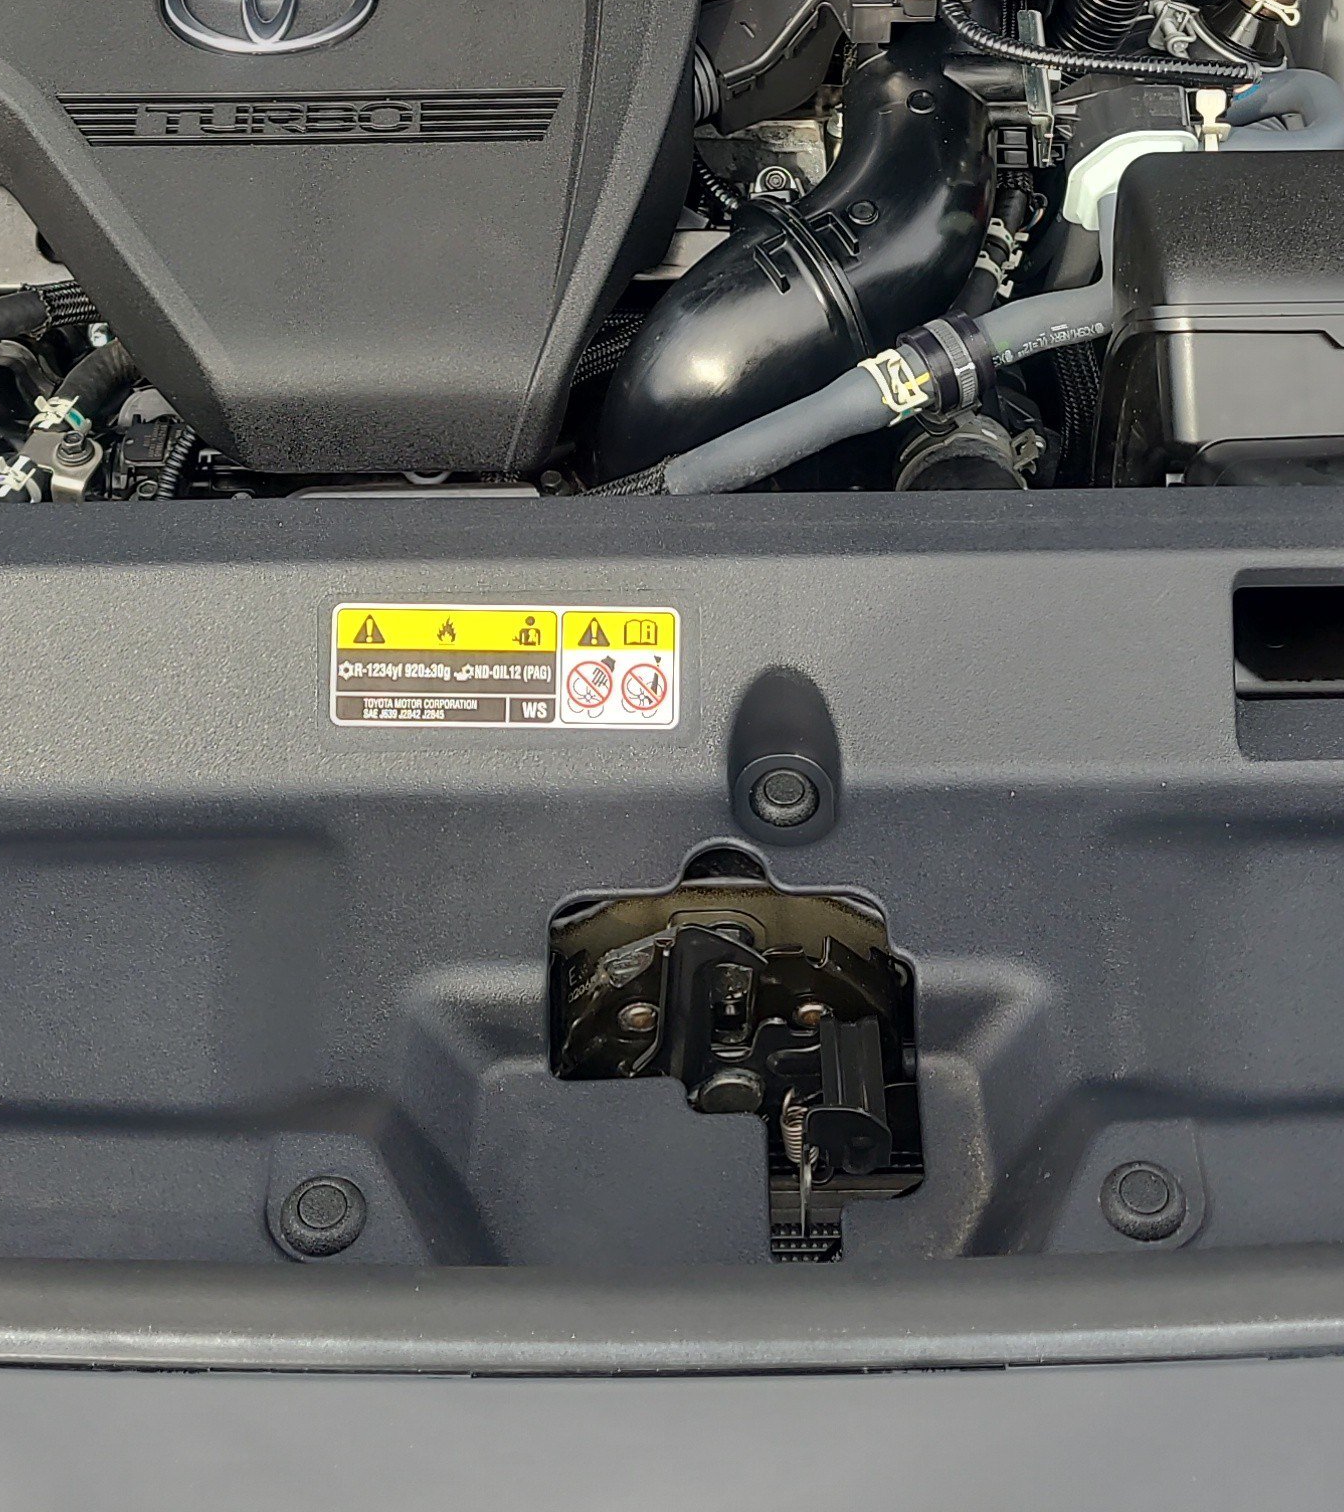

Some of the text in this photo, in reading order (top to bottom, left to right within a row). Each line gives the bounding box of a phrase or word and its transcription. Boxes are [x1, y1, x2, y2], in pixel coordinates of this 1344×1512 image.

[142, 102, 420, 136] TURBO
[353, 663, 551, 683] R-1234yf 920±30g ND-OIL12 (PAG)
[363, 698, 478, 710] TOYOTA MOTOR CORPORATION
[522, 702, 548, 719] WS
[363, 709, 378, 720] SAE
